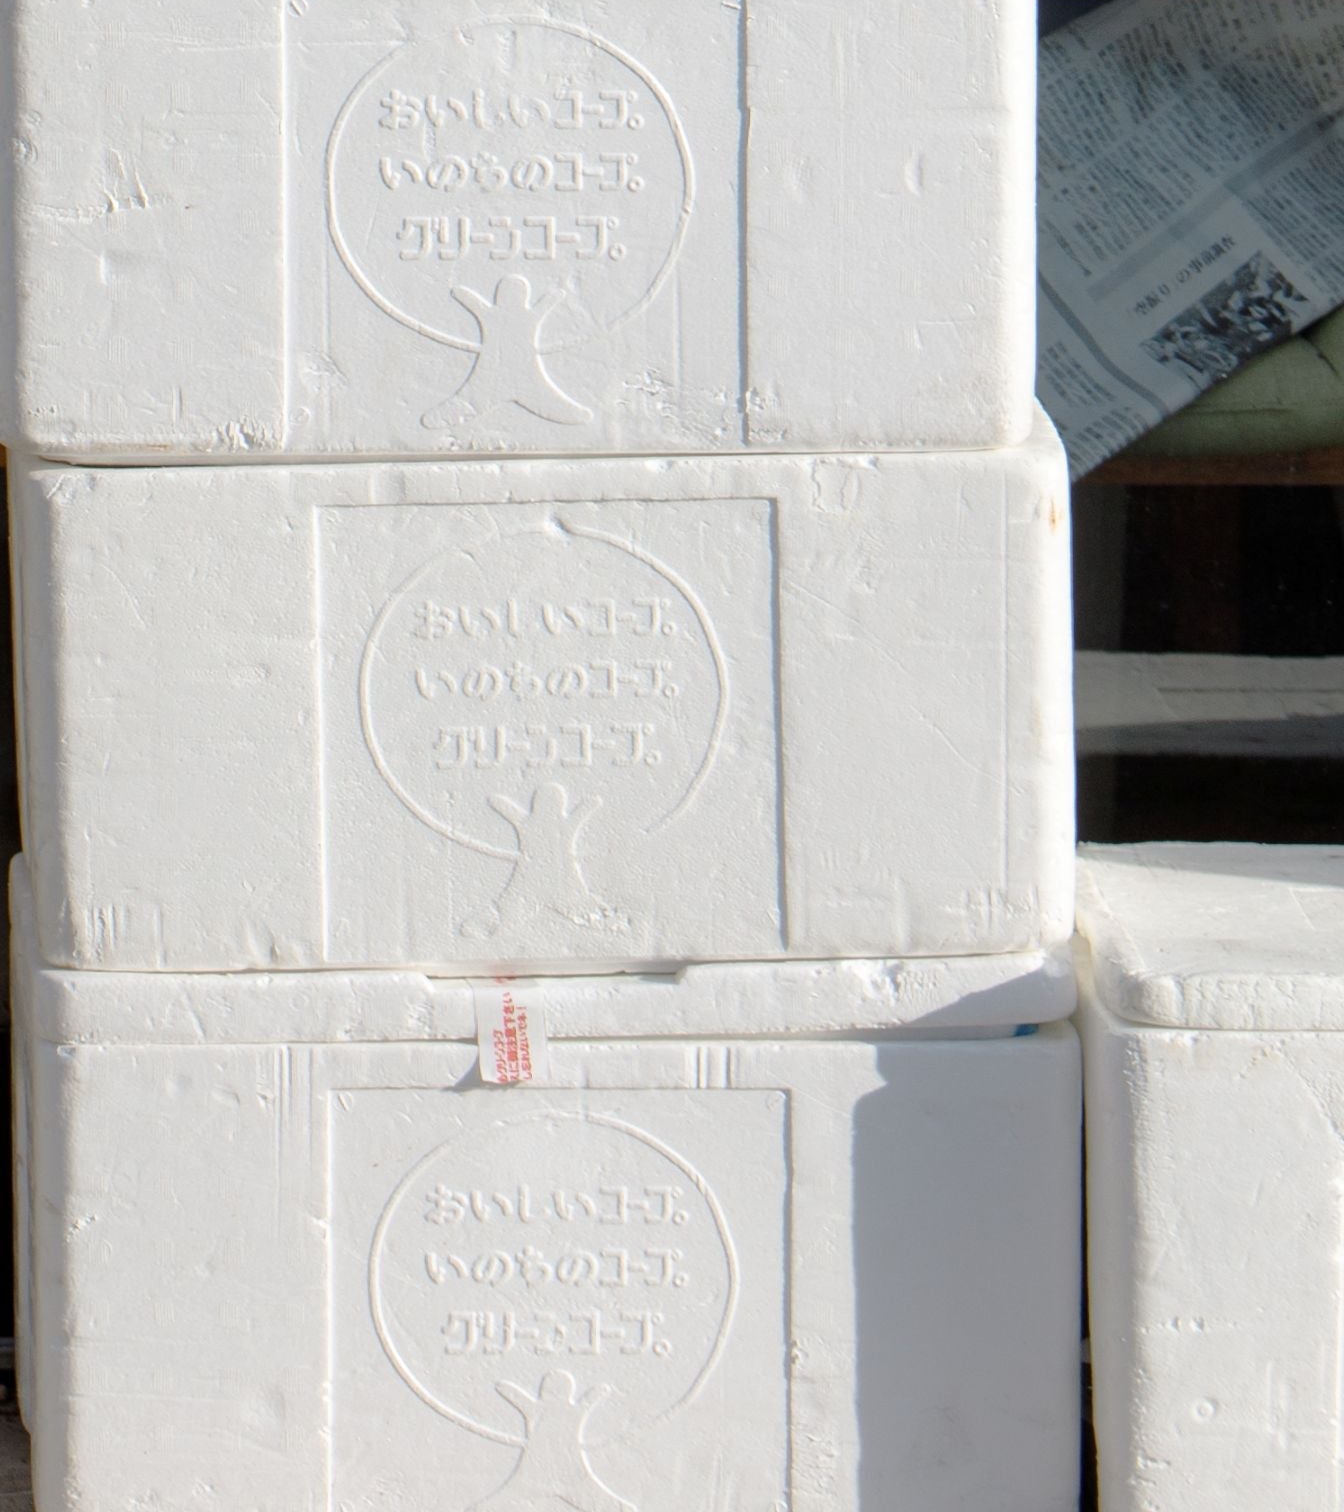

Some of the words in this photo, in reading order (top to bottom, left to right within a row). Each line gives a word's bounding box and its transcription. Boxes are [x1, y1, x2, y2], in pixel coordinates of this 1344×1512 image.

[378, 87, 645, 131] おいしいコープ。
[378, 150, 645, 194] いのちのコープ。
[396, 214, 627, 262] グリーンコープ。
[415, 657, 681, 702] いのちのコープ。
[433, 721, 663, 770] グリーンコープ。
[424, 1182, 690, 1226] おいしいコープ。
[424, 1244, 690, 1288] いのちのコープ。
[440, 1308, 673, 1357] グリーンコープ。
